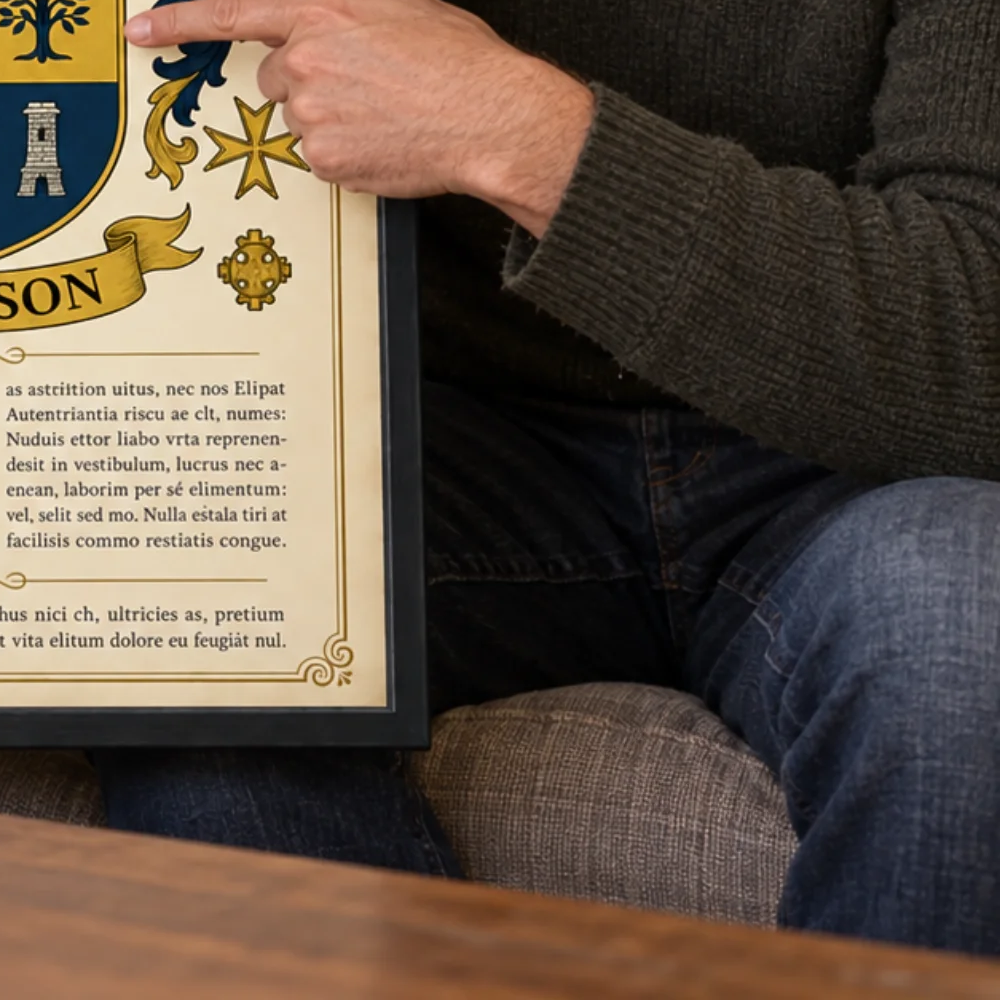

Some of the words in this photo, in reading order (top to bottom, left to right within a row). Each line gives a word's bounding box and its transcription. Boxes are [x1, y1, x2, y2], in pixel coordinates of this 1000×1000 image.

[5, 385, 23, 397] as
[111, 380, 161, 398] uitus,
[165, 384, 195, 397] nec
[200, 384, 229, 397] nos
[234, 379, 286, 400] Elipat
[5, 405, 119, 422] Autentriantia
[123, 405, 165, 422] riscu
[170, 409, 190, 422] ae
[226, 409, 286, 422] numes:
[6, 431, 65, 448] Nuduis
[69, 433, 112, 447] ettor
[117, 430, 161, 447] liabo
[205, 434, 288, 451] reprenen-
[5, 455, 45, 473] desit
[51, 456, 68, 472] in
[73, 455, 171, 474] vestibulum,
[176, 455, 229, 472] lucrus
[234, 459, 265, 472] nec
[269, 459, 287, 472] a-
[5, 485, 59, 499] enean,
[63, 480, 129, 497] laborim
[134, 485, 162, 501] per
[166, 480, 184, 497] sé
[188, 480, 287, 497] elimentum:
[6, 506, 35, 524] vel,
[38, 506, 72, 523] selit
[76, 506, 104, 523] sed
[108, 510, 139, 523] mo.
[143, 505, 188, 523] Nulla
[241, 506, 268, 523] tiri
[271, 509, 287, 522] at
[6, 531, 71, 549] facilisis
[74, 535, 141, 549] commo
[145, 532, 215, 548] restiatis
[218, 535, 287, 553] congue.
[34, 605, 68, 623] nici
[73, 605, 100, 624] ch,
[107, 605, 179, 623] ultricies
[184, 610, 208, 625] as,
[214, 605, 285, 627] pretium
[11, 632, 45, 649] vita
[48, 631, 105, 649] elitum
[109, 631, 164, 649] dolore
[168, 636, 189, 649] eu
[254, 631, 287, 649] nul.
